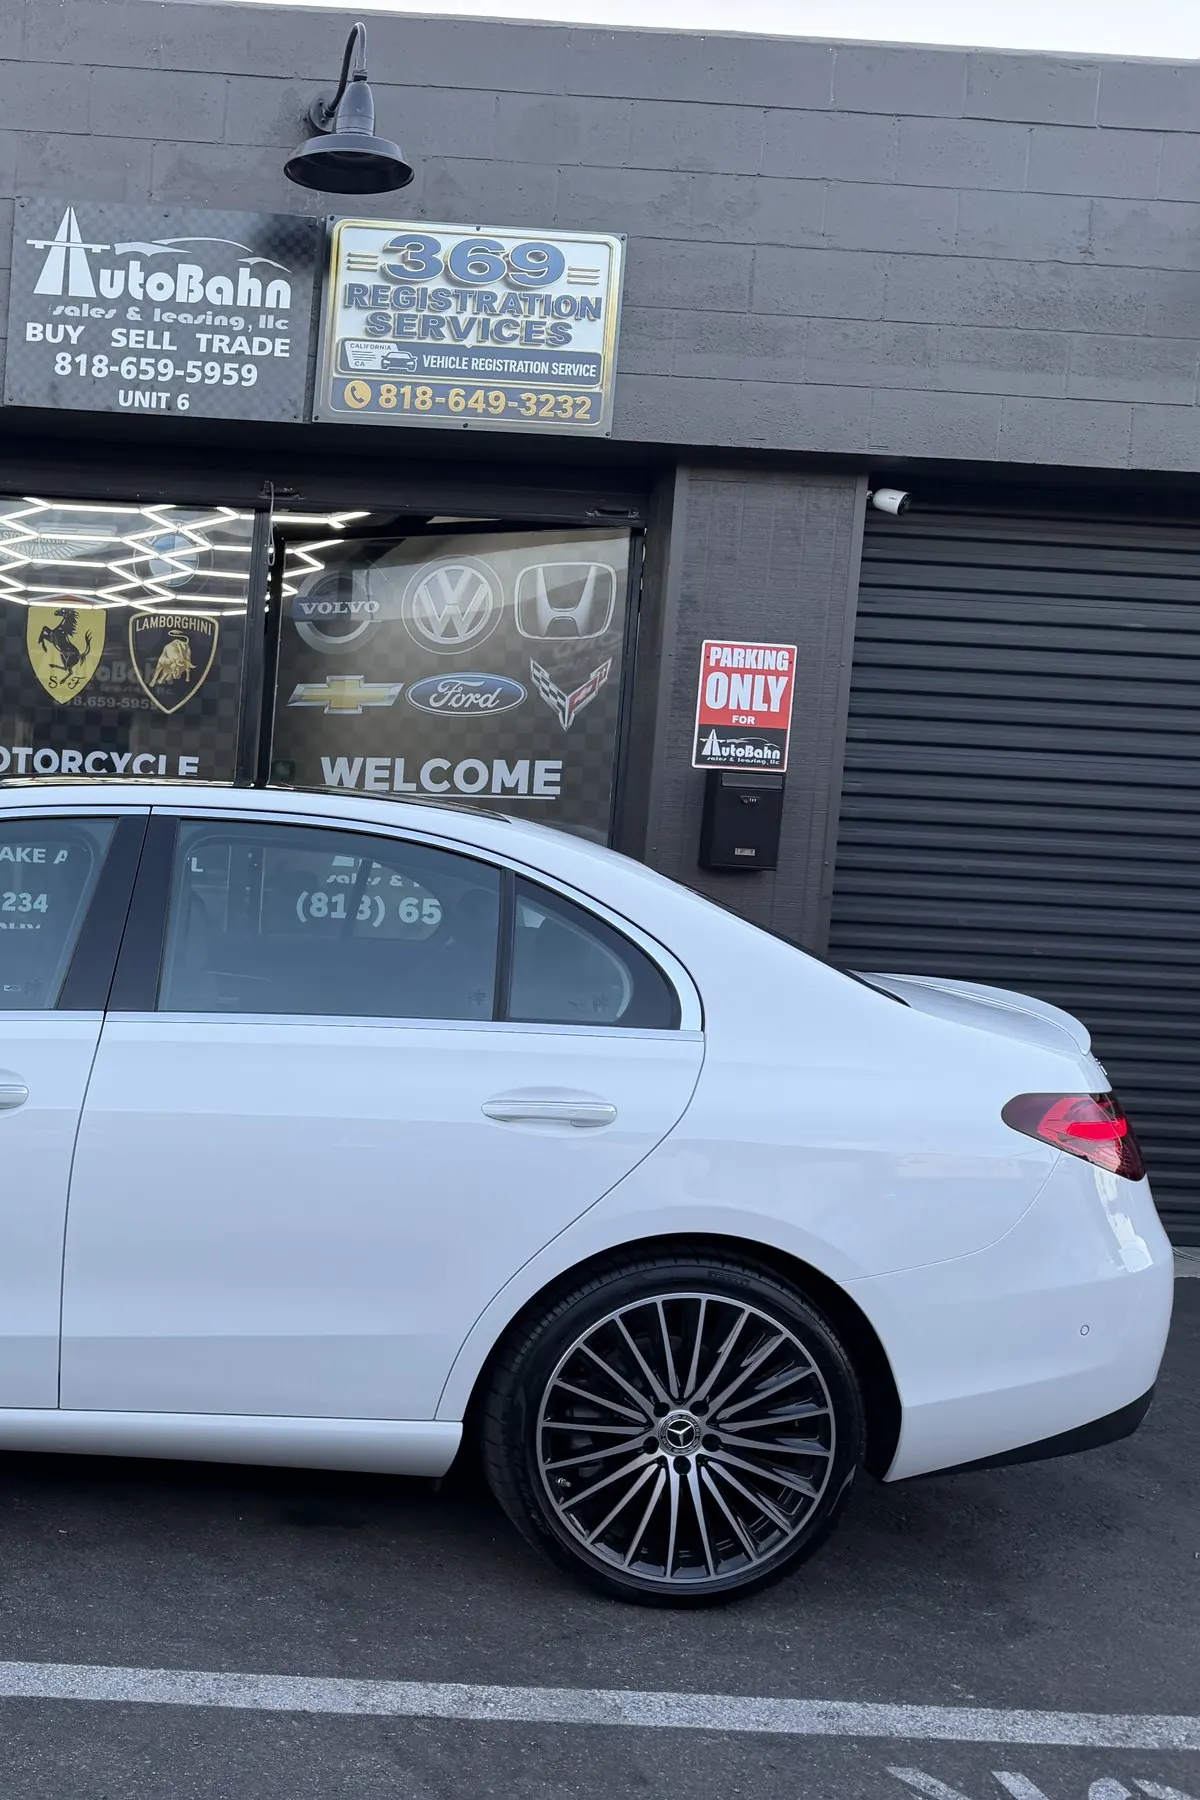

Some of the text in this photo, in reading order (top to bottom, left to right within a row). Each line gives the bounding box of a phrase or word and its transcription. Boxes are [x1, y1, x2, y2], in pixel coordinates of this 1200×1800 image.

[26, 206, 292, 309] AutoBahn
[383, 234, 566, 288] 369
[344, 283, 602, 320] REGISTRATION
[52, 304, 289, 332] sales & leasing, llc
[365, 311, 574, 347] SERVICES
[26, 322, 291, 357] BUY SELL TRADE
[349, 342, 392, 351] CALIFORNIA
[54, 352, 258, 386] 818-659-5959
[423, 354, 596, 378] VEHICLE REGISTRATION SERVICE
[118, 390, 190, 410] UNIT 6
[378, 383, 593, 420] 818-649-3232
[299, 600, 380, 616] VOLVO
[135, 615, 212, 636] LAMBORGHINI
[709, 646, 789, 671] PARKING
[428, 679, 502, 709] Ford
[705, 671, 789, 713] ONLY
[732, 715, 755, 725] FOR
[700, 729, 781, 760] AutoBahn
[320, 756, 563, 796] WELCOME
